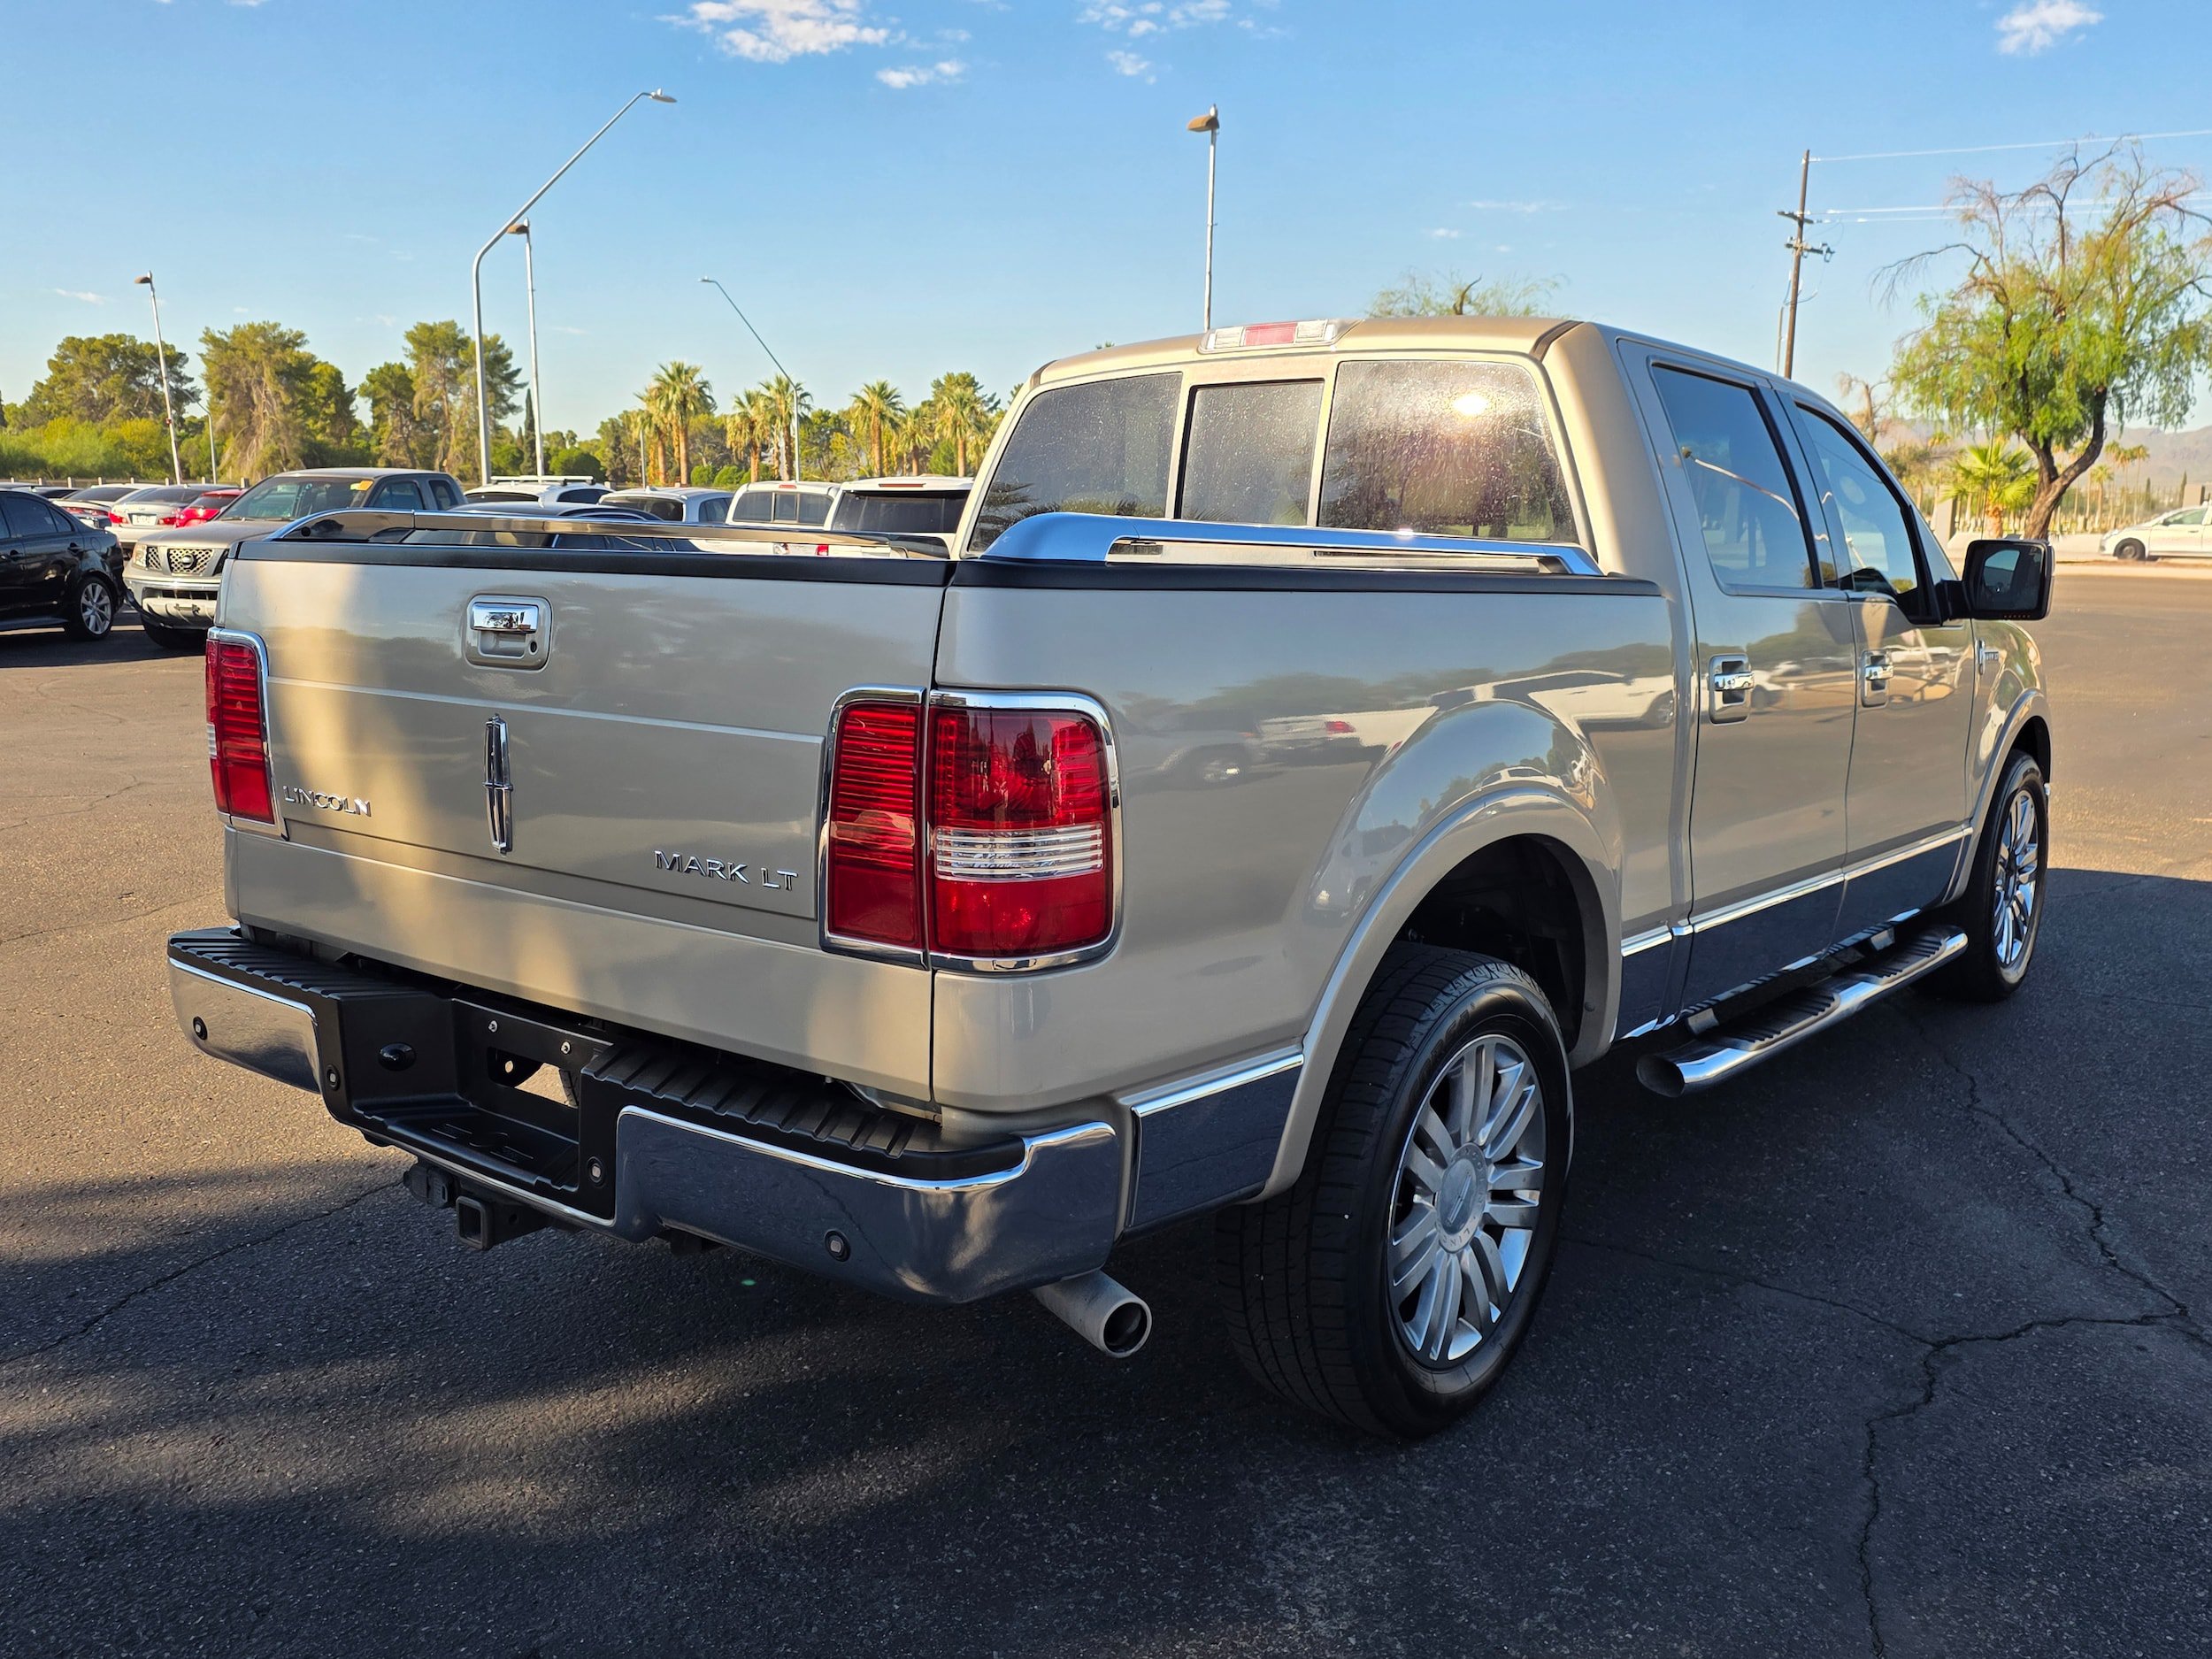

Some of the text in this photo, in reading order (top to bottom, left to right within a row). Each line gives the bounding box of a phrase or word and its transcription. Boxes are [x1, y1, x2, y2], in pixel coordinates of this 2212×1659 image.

[283, 785, 372, 818] LINCOLN
[654, 849, 798, 891] MARK LT
